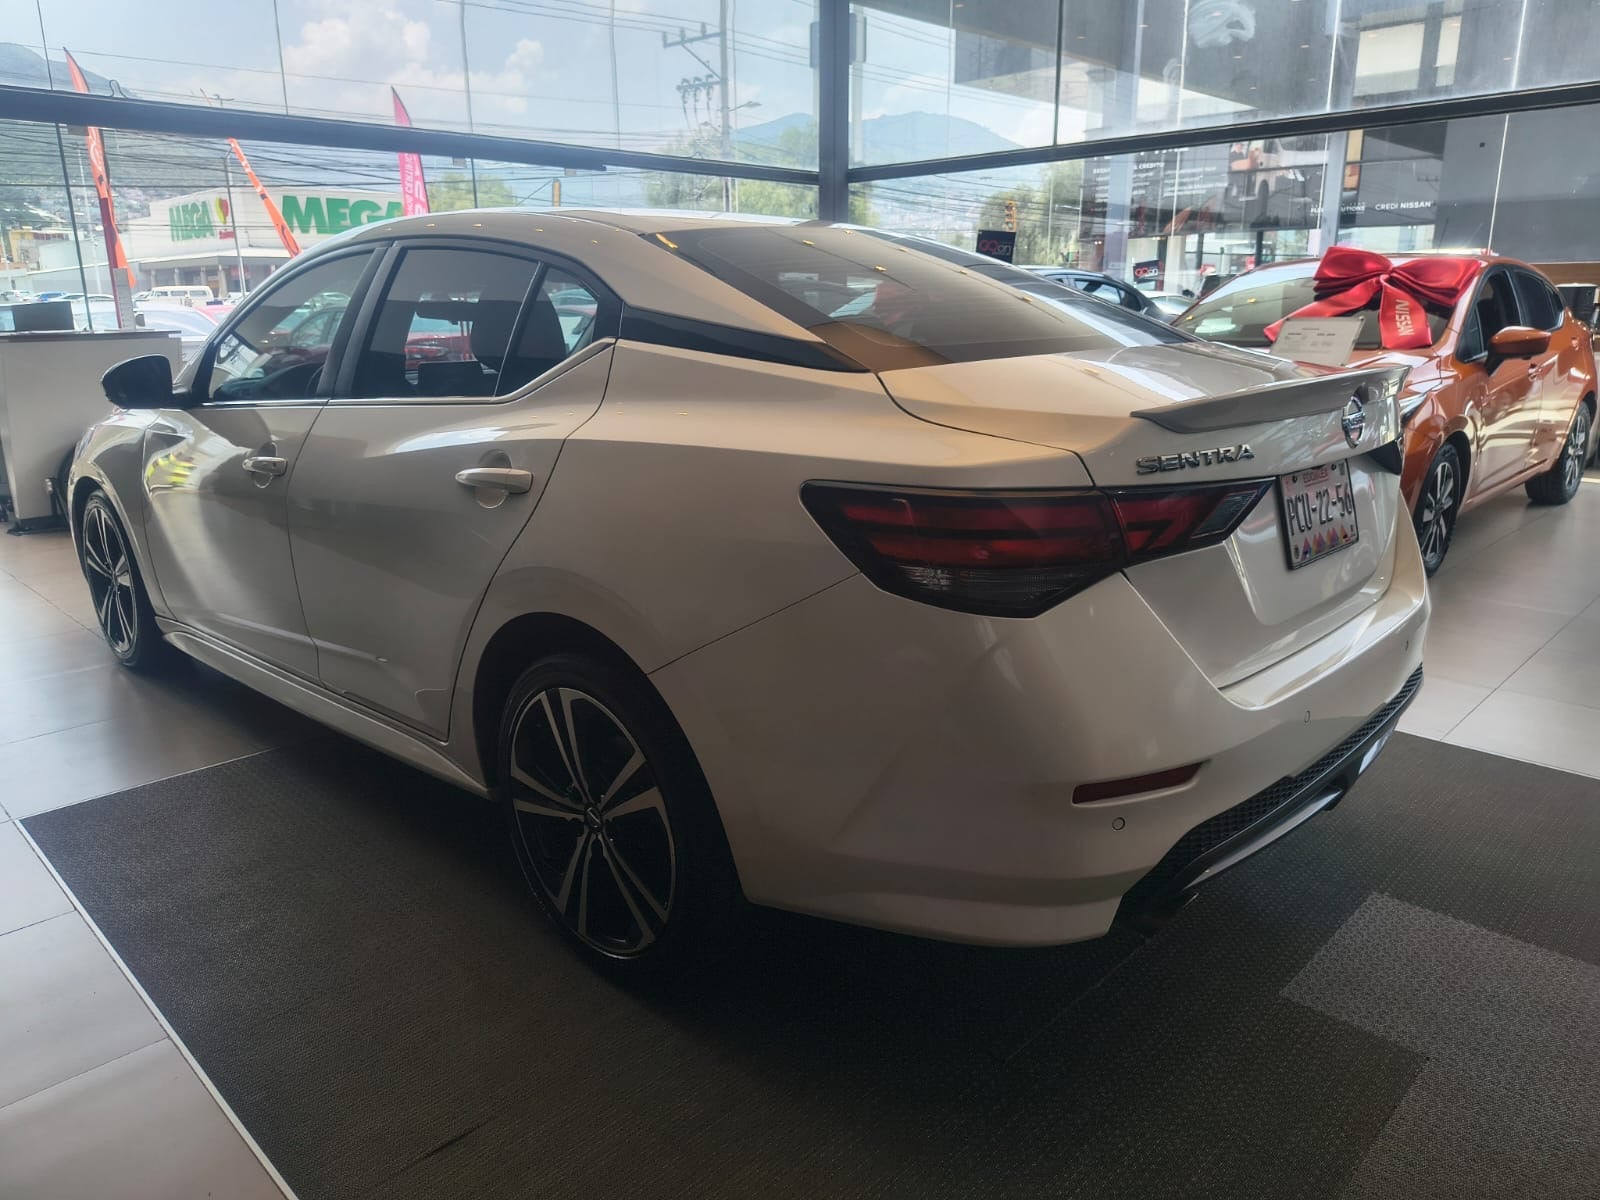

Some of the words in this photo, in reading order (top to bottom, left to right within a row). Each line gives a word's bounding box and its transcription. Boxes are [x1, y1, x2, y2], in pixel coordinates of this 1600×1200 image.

[169, 200, 215, 242] MEGA
[1375, 203, 1399, 211] CREDI
[1400, 200, 1432, 209] NISSAN
[1136, 443, 1255, 475] SENTRA
[1286, 482, 1353, 537] PCU-22-56
